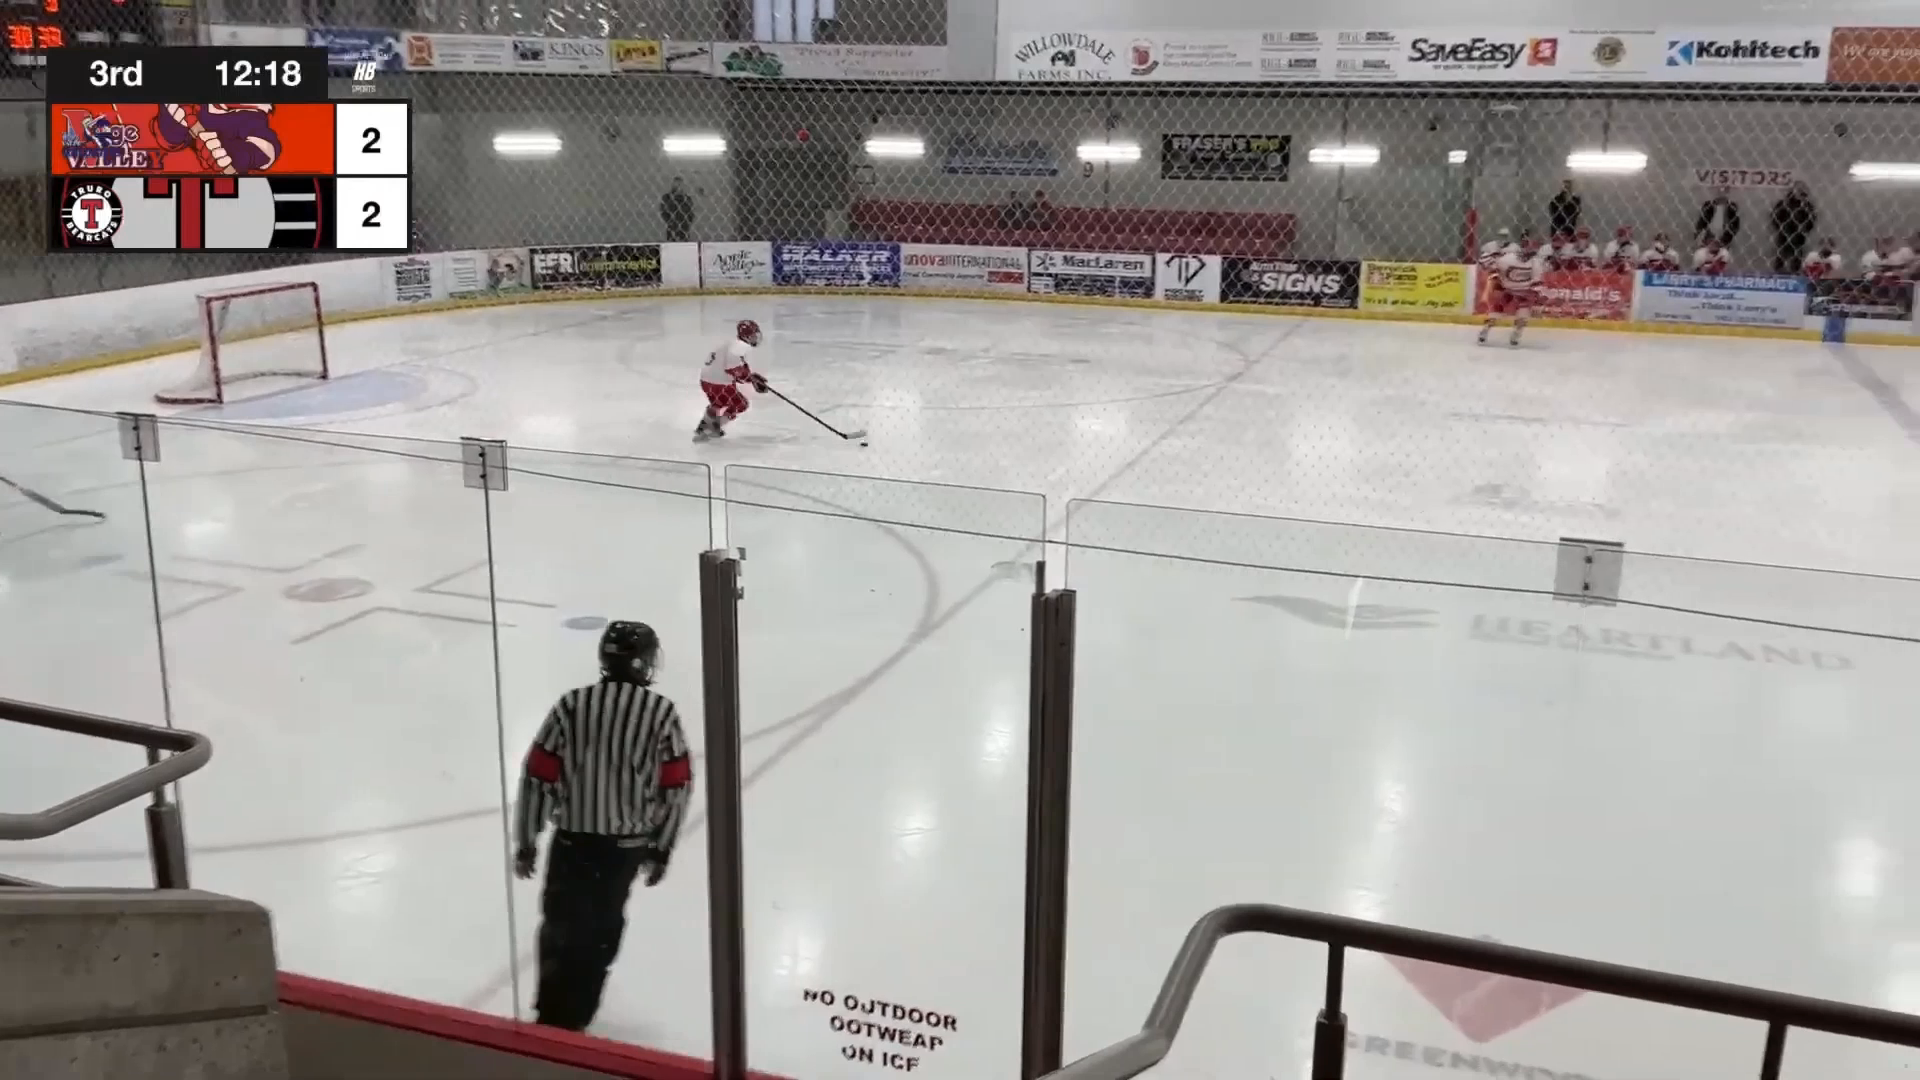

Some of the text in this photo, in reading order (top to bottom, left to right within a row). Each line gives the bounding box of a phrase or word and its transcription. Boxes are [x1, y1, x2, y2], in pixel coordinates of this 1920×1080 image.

[551, 42, 605, 57] KINGS
[1015, 33, 1116, 65] WILLOWDALE
[1408, 37, 1527, 69] SaveEasy
[1696, 39, 1820, 59] Kohltech
[1018, 70, 1070, 80] FARMS
[1083, 161, 1095, 178] 9
[1695, 169, 1793, 186] VISITORS
[1061, 254, 1145, 271] MacLaren
[1261, 272, 1341, 294] SIGNS
[1470, 614, 1856, 671] HEARTLAND
[803, 988, 958, 1032] NO OUTDOOR
[841, 1044, 873, 1063] ON
